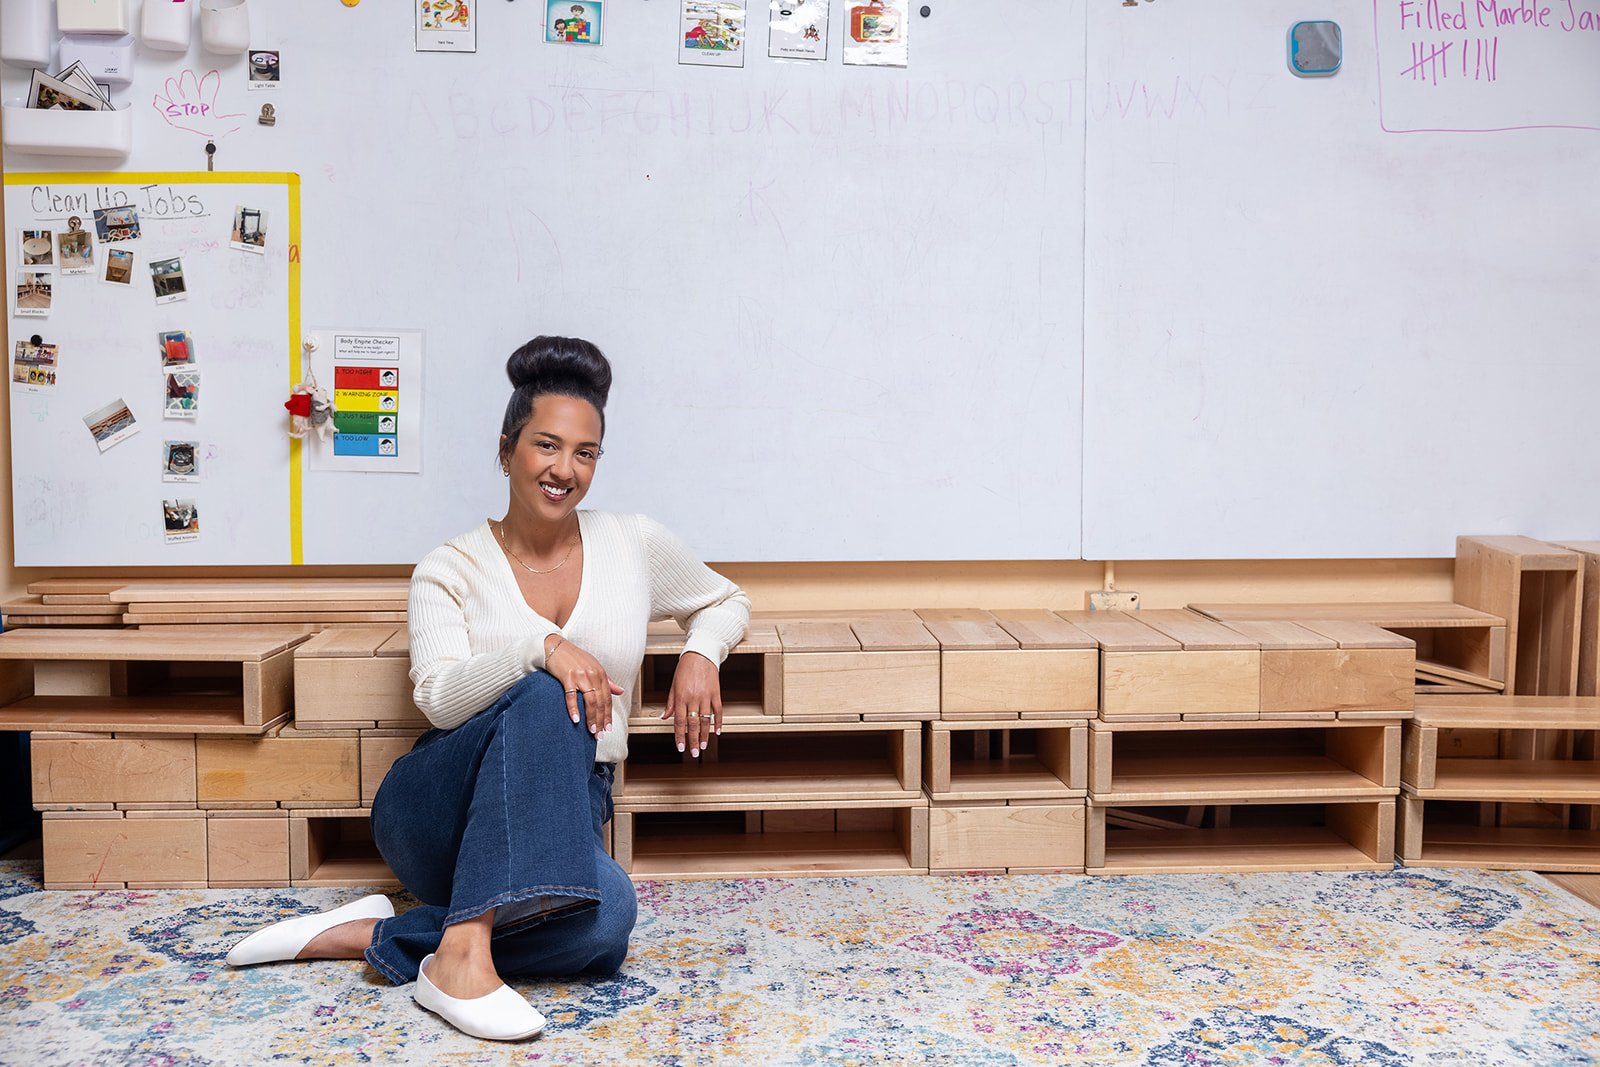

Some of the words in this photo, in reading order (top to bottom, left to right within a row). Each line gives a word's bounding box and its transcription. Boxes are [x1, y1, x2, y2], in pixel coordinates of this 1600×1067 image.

[1400, 0, 1467, 31] Filled
[1476, 0, 1551, 28] Marble
[166, 103, 210, 117] STOP
[31, 186, 88, 213] Clean
[140, 184, 206, 215] Jobs
